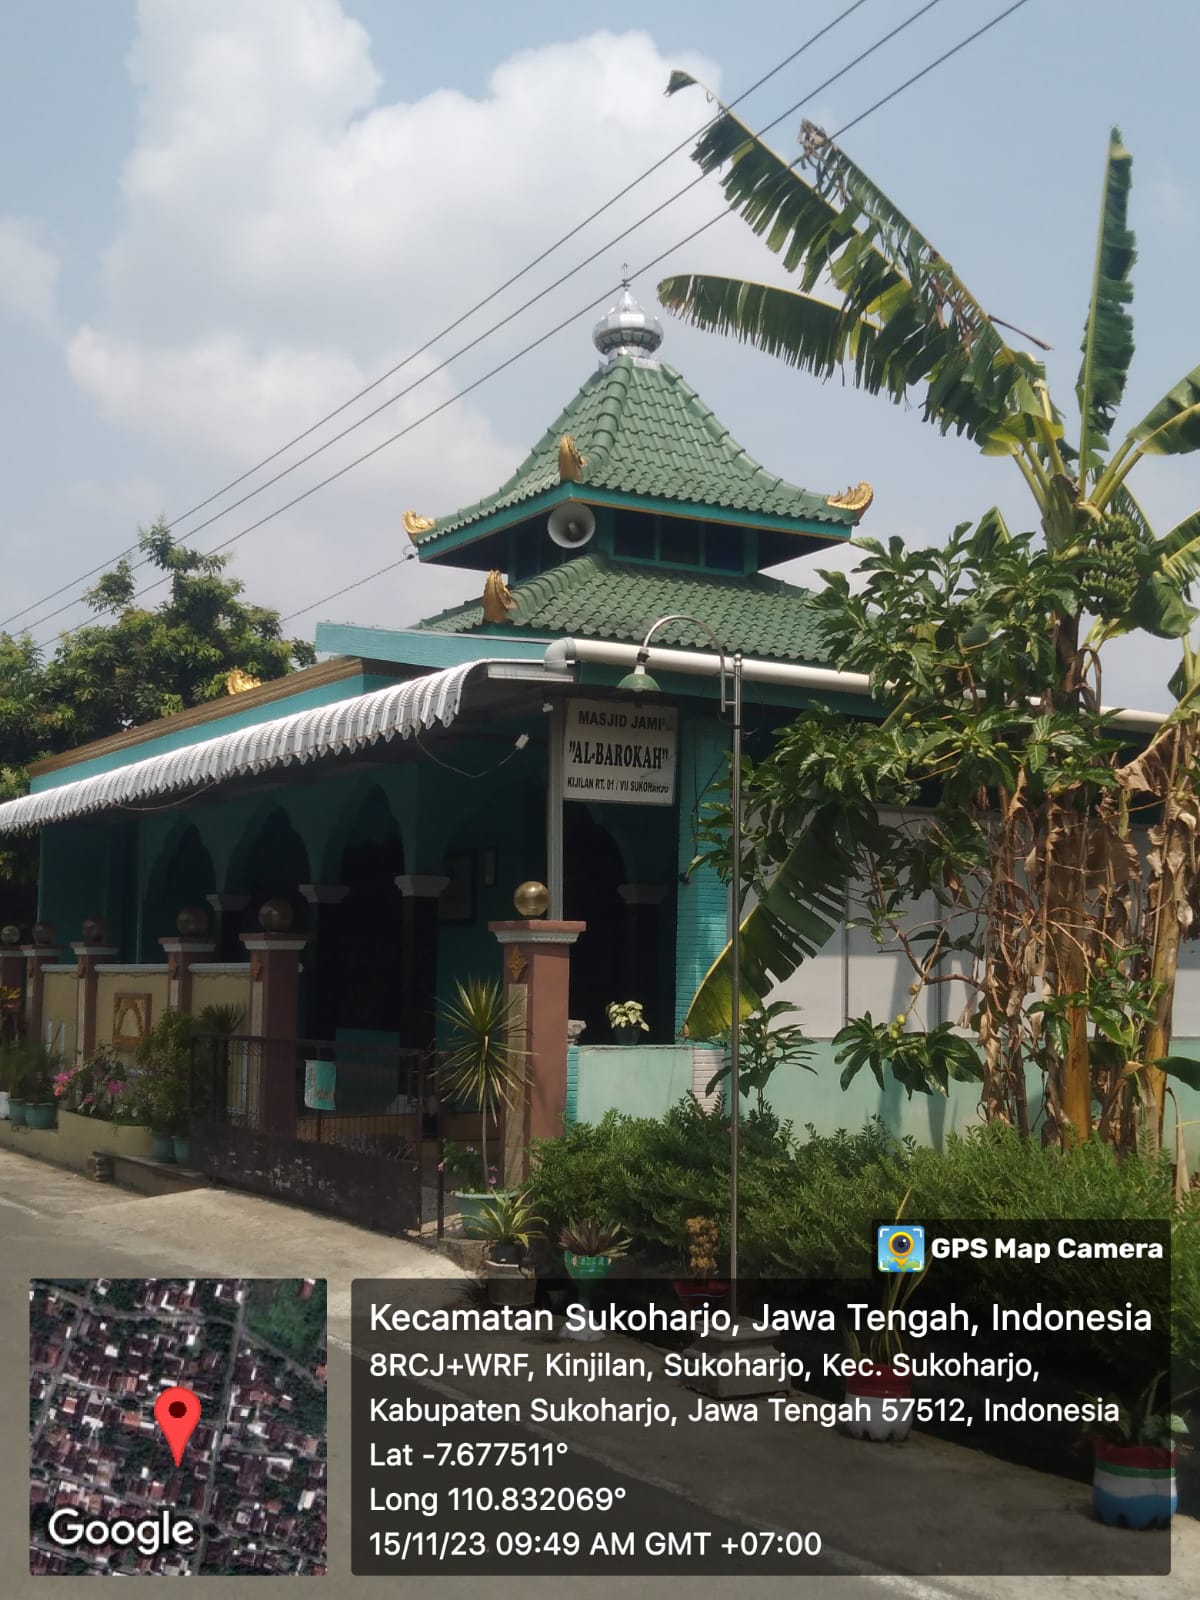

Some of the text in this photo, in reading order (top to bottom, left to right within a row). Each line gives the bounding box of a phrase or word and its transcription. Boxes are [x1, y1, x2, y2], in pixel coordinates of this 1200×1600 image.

[578, 711, 627, 729] MASJID
[567, 776, 594, 789] KIJILAN
[595, 778, 606, 790] RT.
[619, 780, 629, 792] VII
